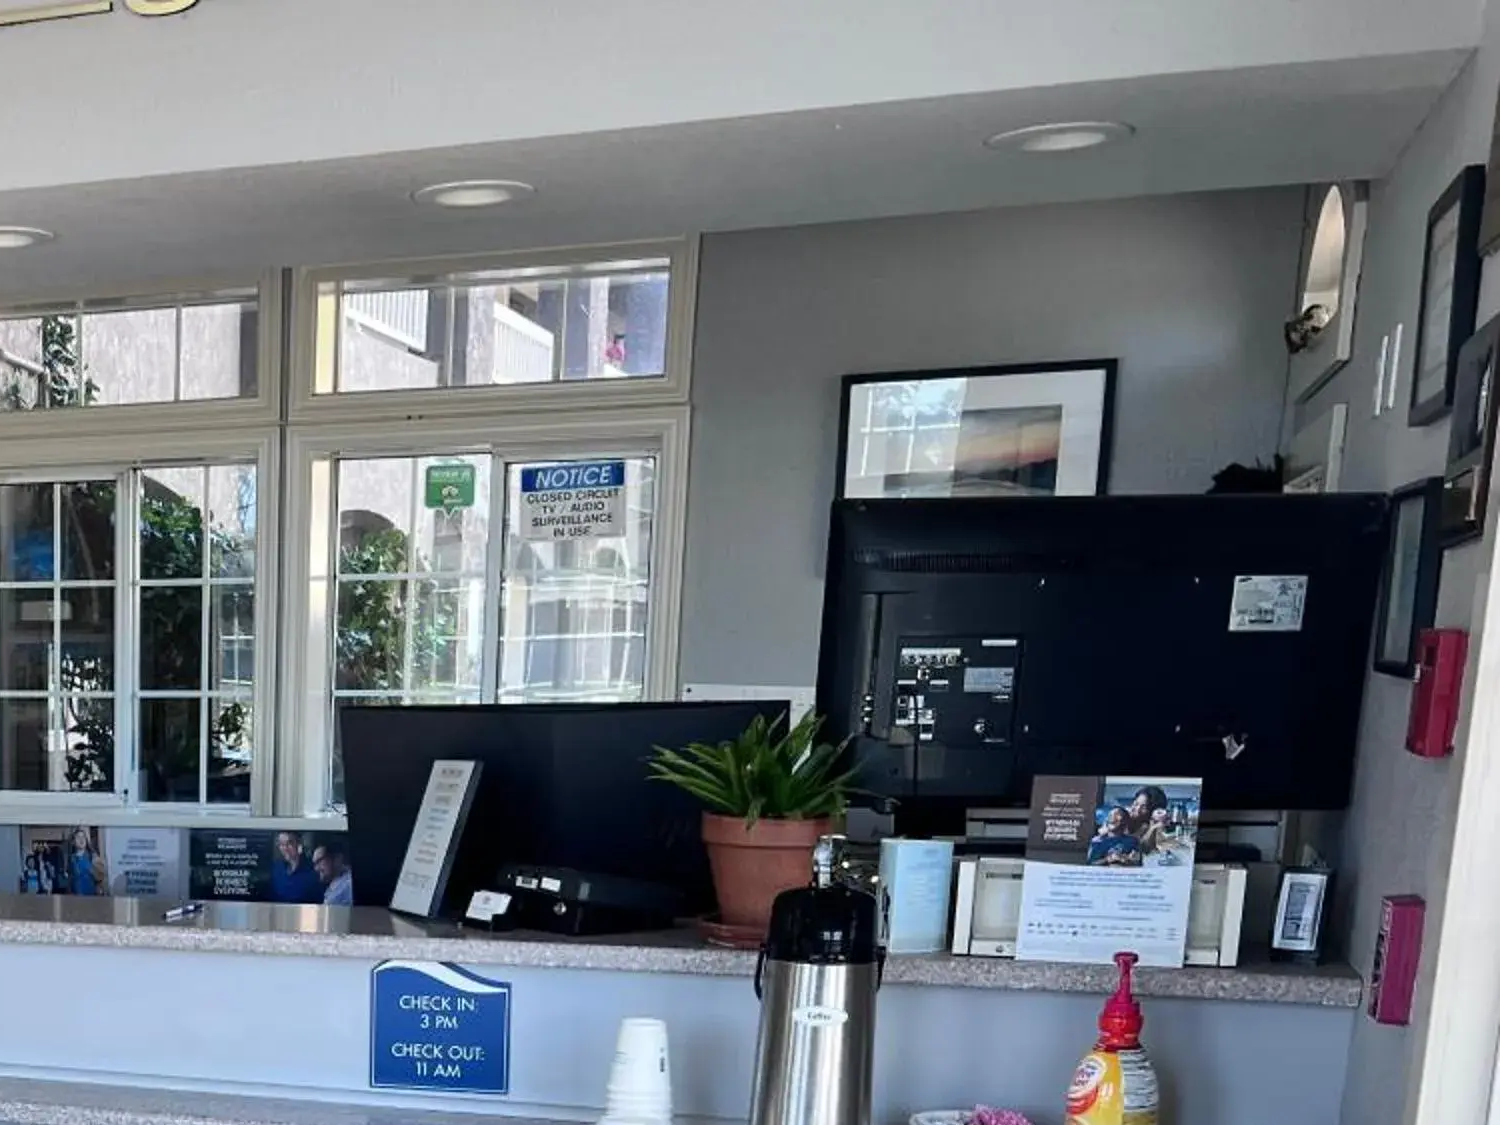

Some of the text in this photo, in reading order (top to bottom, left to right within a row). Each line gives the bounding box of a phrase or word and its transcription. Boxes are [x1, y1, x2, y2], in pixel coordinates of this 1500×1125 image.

[535, 465, 612, 489] NOTICE
[527, 487, 619, 504] CLOSED CIRCUIT
[542, 504, 557, 514] TV
[570, 501, 605, 513] AUDIO
[531, 512, 613, 527] SURVEILLANCE
[553, 525, 592, 538] IN USE
[399, 995, 452, 1011] CHECK
[420, 1013, 459, 1030] 3 PM
[391, 1042, 444, 1060] CHECK
[416, 1061, 462, 1079] 11 AM
